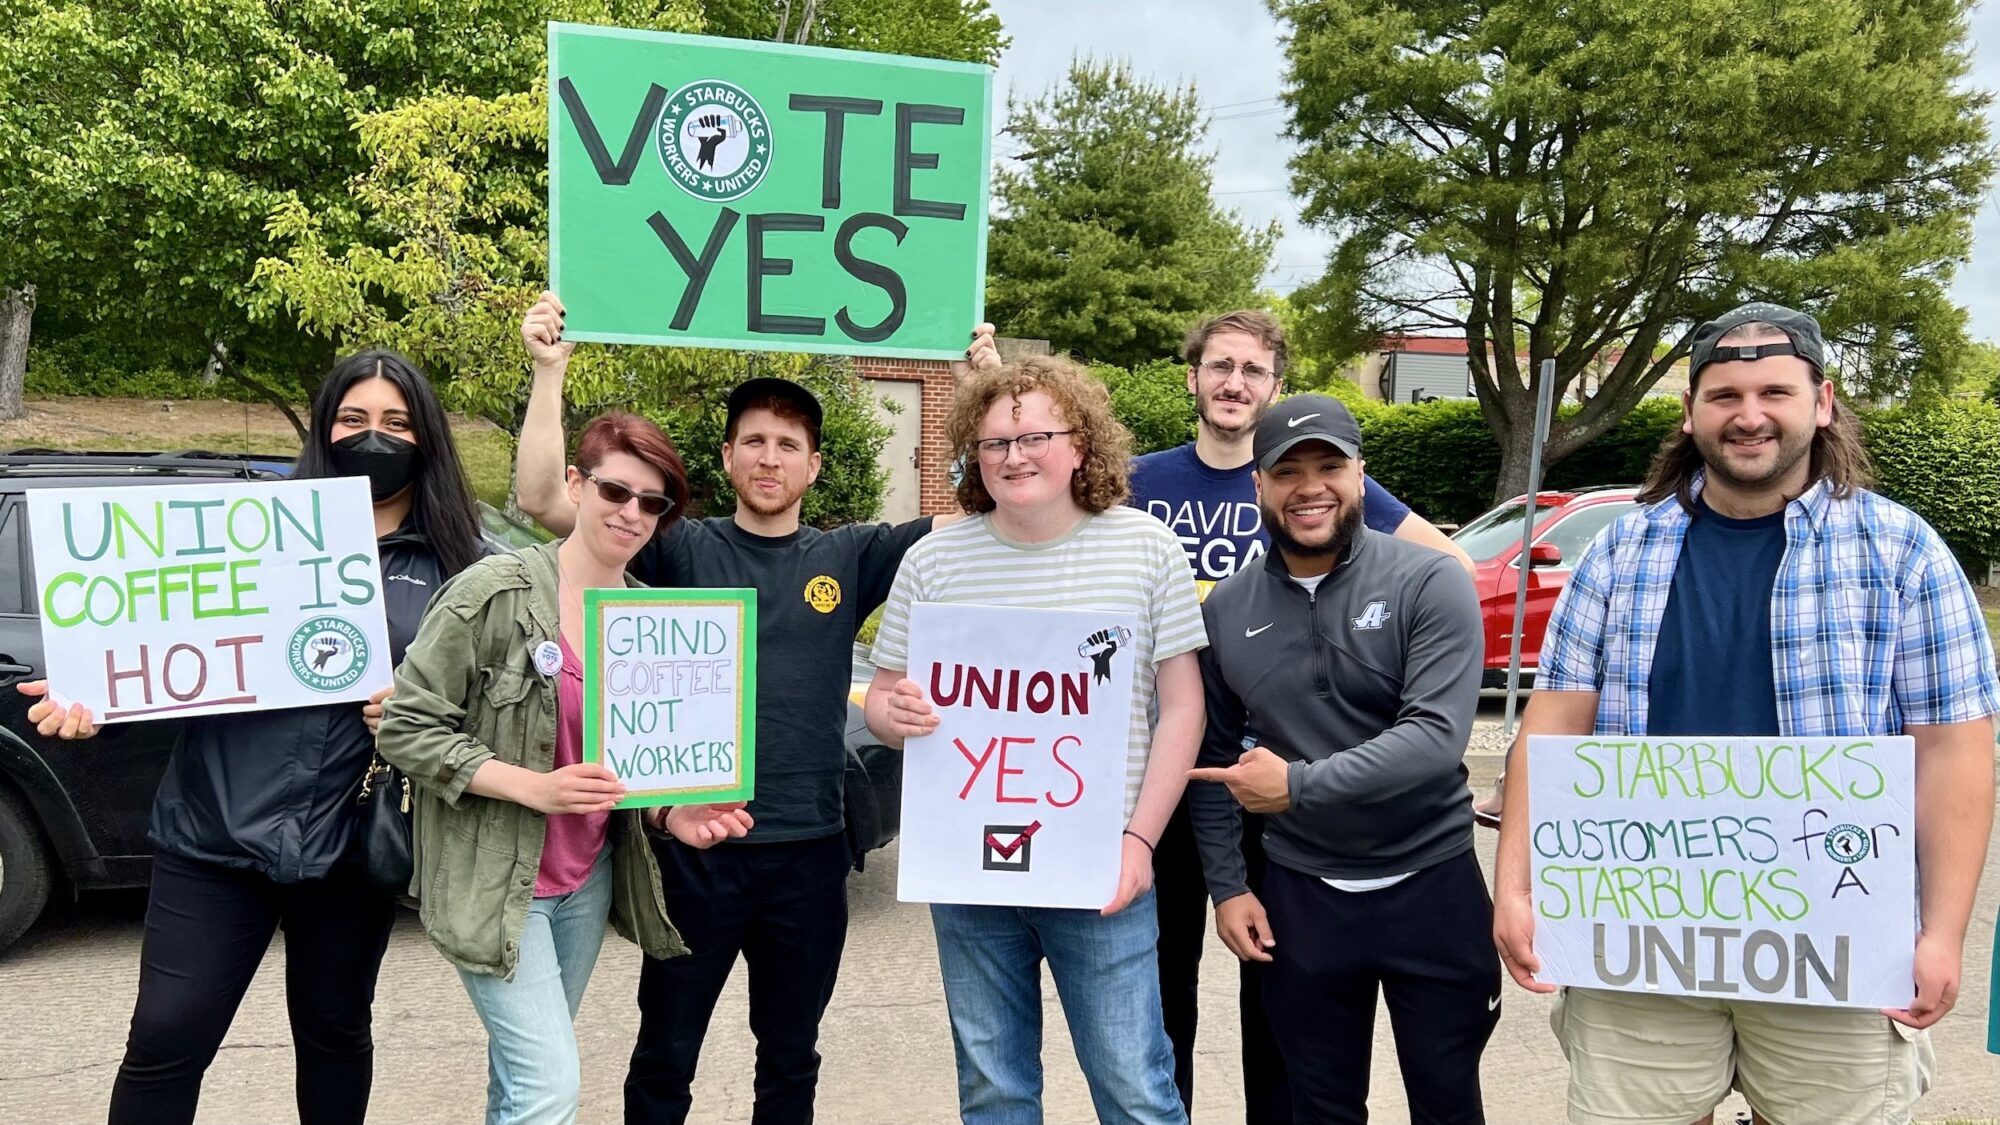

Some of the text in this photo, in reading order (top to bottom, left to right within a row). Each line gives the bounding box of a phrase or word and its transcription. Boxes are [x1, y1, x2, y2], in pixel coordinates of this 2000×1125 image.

[662, 87, 765, 193] STARBUCKS UNITED WORKERS
[646, 207, 909, 343] YES
[62, 489, 325, 561] UNION
[1147, 499, 1262, 536] DAVID
[44, 553, 375, 628] COFFEE IS
[291, 619, 366, 687] STARBUCKS UNITED WORKERS
[606, 615, 727, 656] GRIND
[105, 635, 263, 708] HOT
[605, 659, 731, 696] COFFEE
[929, 662, 1089, 716] UNION
[610, 698, 683, 739] NOT
[607, 741, 734, 779] WORKERS
[953, 735, 1084, 808] YES
[1573, 741, 1885, 801] STARBUCKS
[1534, 815, 1779, 864] CUSTOMERS
[1539, 865, 1870, 922] STARBUCKS A
[1593, 923, 1850, 1002] UNION
